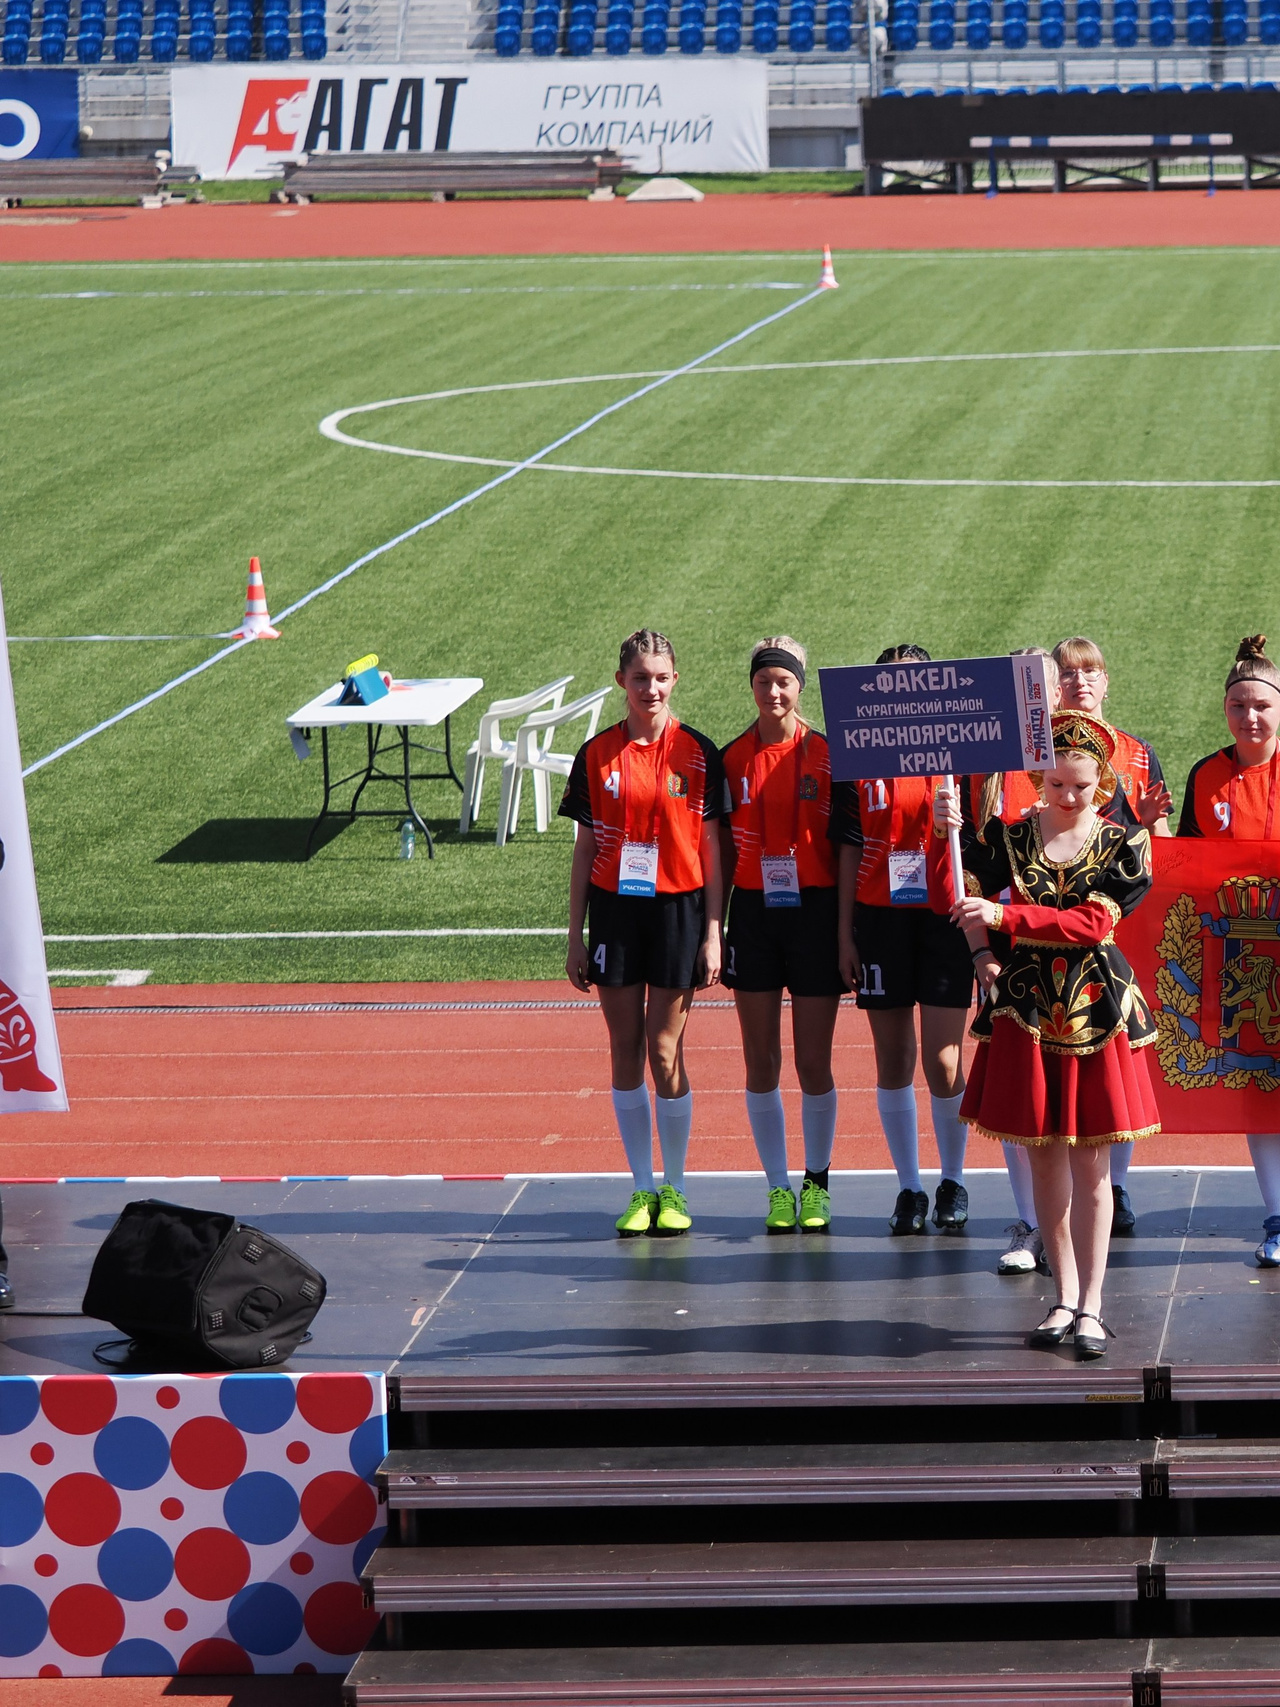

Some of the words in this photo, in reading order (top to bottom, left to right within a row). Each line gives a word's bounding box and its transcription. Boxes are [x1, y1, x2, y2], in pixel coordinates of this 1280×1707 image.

[543, 84, 664, 111] ГРУППА
[302, 77, 469, 152] АГАТ
[536, 113, 714, 147] КОМПАНИЙ
[860, 666, 975, 694] «ФАКЕЛ»
[856, 699, 943, 718] КУРАГИНСКИЙ
[945, 696, 984, 712] РАЙОН
[844, 717, 1002, 749] КРАСНОЯРСКИЙ
[899, 747, 953, 773] КРАЙ
[603, 771, 621, 799] 4
[740, 776, 751, 805] 1
[864, 779, 888, 813] 11
[1213, 801, 1231, 832] 9
[622, 884, 652, 892] УЧАСТНИК
[593, 943, 607, 974] 4
[860, 963, 886, 996] 11
